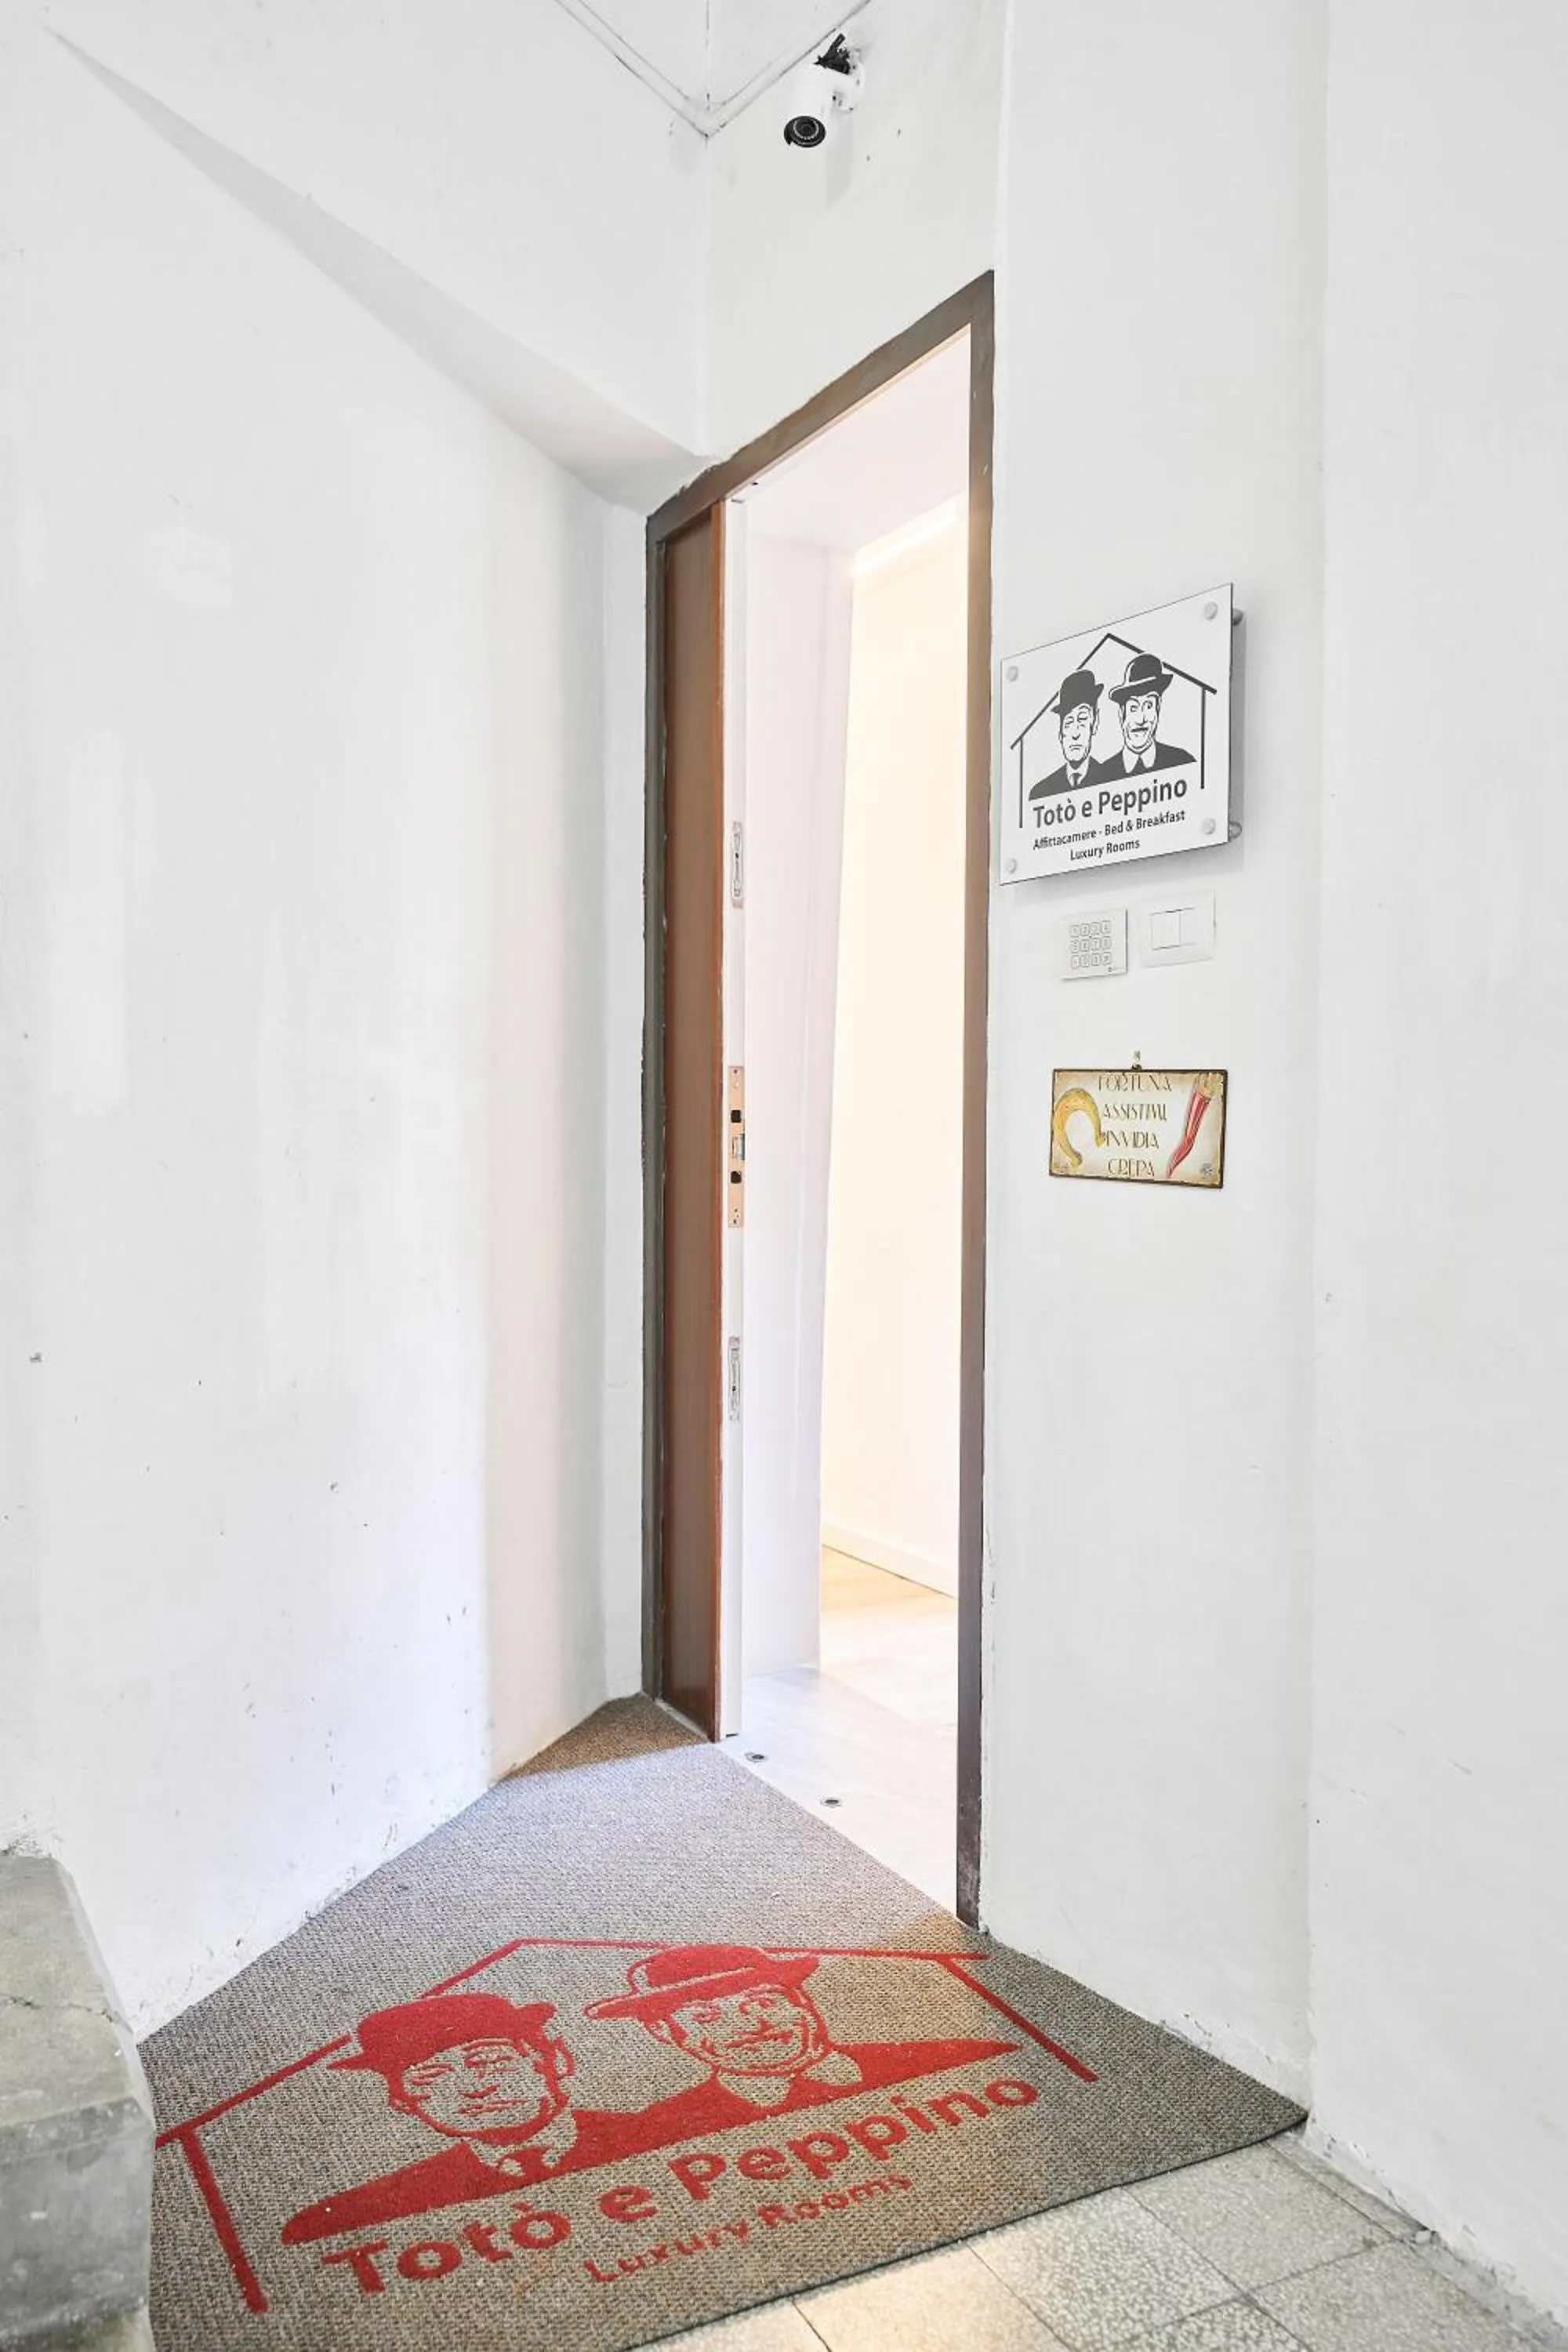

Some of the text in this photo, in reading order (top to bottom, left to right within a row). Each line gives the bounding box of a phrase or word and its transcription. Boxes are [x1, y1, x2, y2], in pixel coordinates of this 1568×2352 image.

[1033, 779, 1188, 828] Totò e Peppino
[1033, 829, 1097, 851] Affittacamere
[1105, 821, 1124, 836] Bed
[1126, 819, 1134, 833] &
[1136, 811, 1185, 829] Breakfast
[1070, 840, 1141, 862] Luxury Rooms
[1098, 1074, 1172, 1092] FORTUNA
[1106, 1130, 1160, 1149] INVIDIA
[1108, 1158, 1155, 1176] CREPA
[321, 2078, 1040, 2294] Totò e Peppino
[584, 2175, 912, 2283] Luxury Rooms
